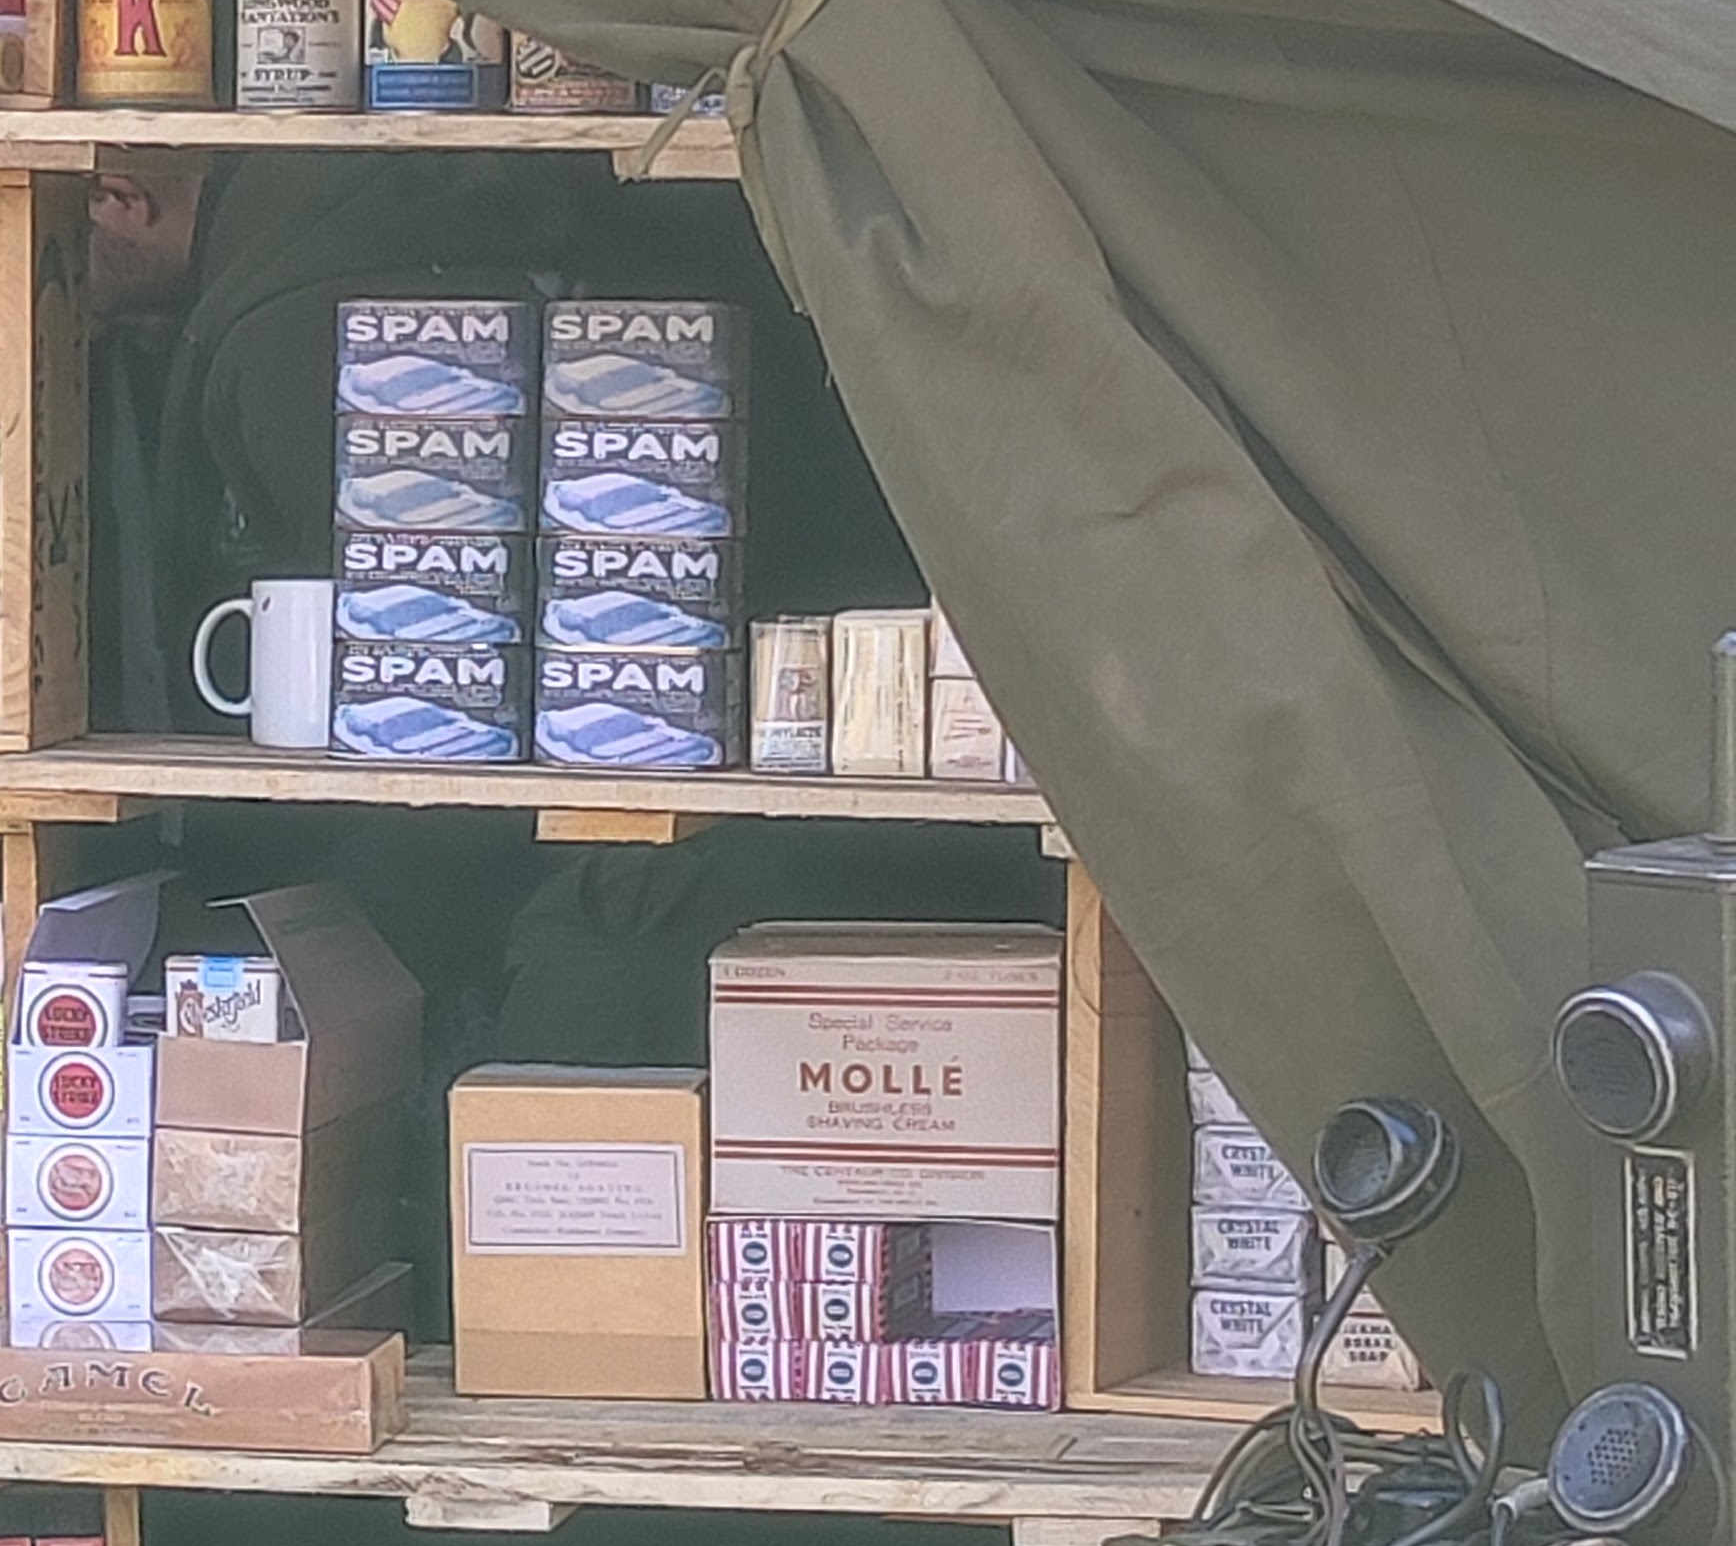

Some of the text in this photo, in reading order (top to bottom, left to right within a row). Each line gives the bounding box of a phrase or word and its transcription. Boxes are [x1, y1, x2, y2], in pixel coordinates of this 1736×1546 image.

[345, 314, 510, 344] SPAM
[549, 314, 715, 345] SPAM
[345, 428, 511, 459] SPAM
[552, 431, 721, 463] SPAM
[344, 543, 509, 573] SPAM
[552, 548, 720, 580] SPAM
[341, 655, 505, 686] SPAM
[540, 660, 705, 693] SPAM
[807, 1012, 953, 1032] Special Service
[841, 1033, 919, 1054] Package
[799, 1055, 963, 1097] MOLLÉ
[1217, 1219, 1280, 1234] CRYSTAL
[1210, 1299, 1272, 1316] CRYSTAL
